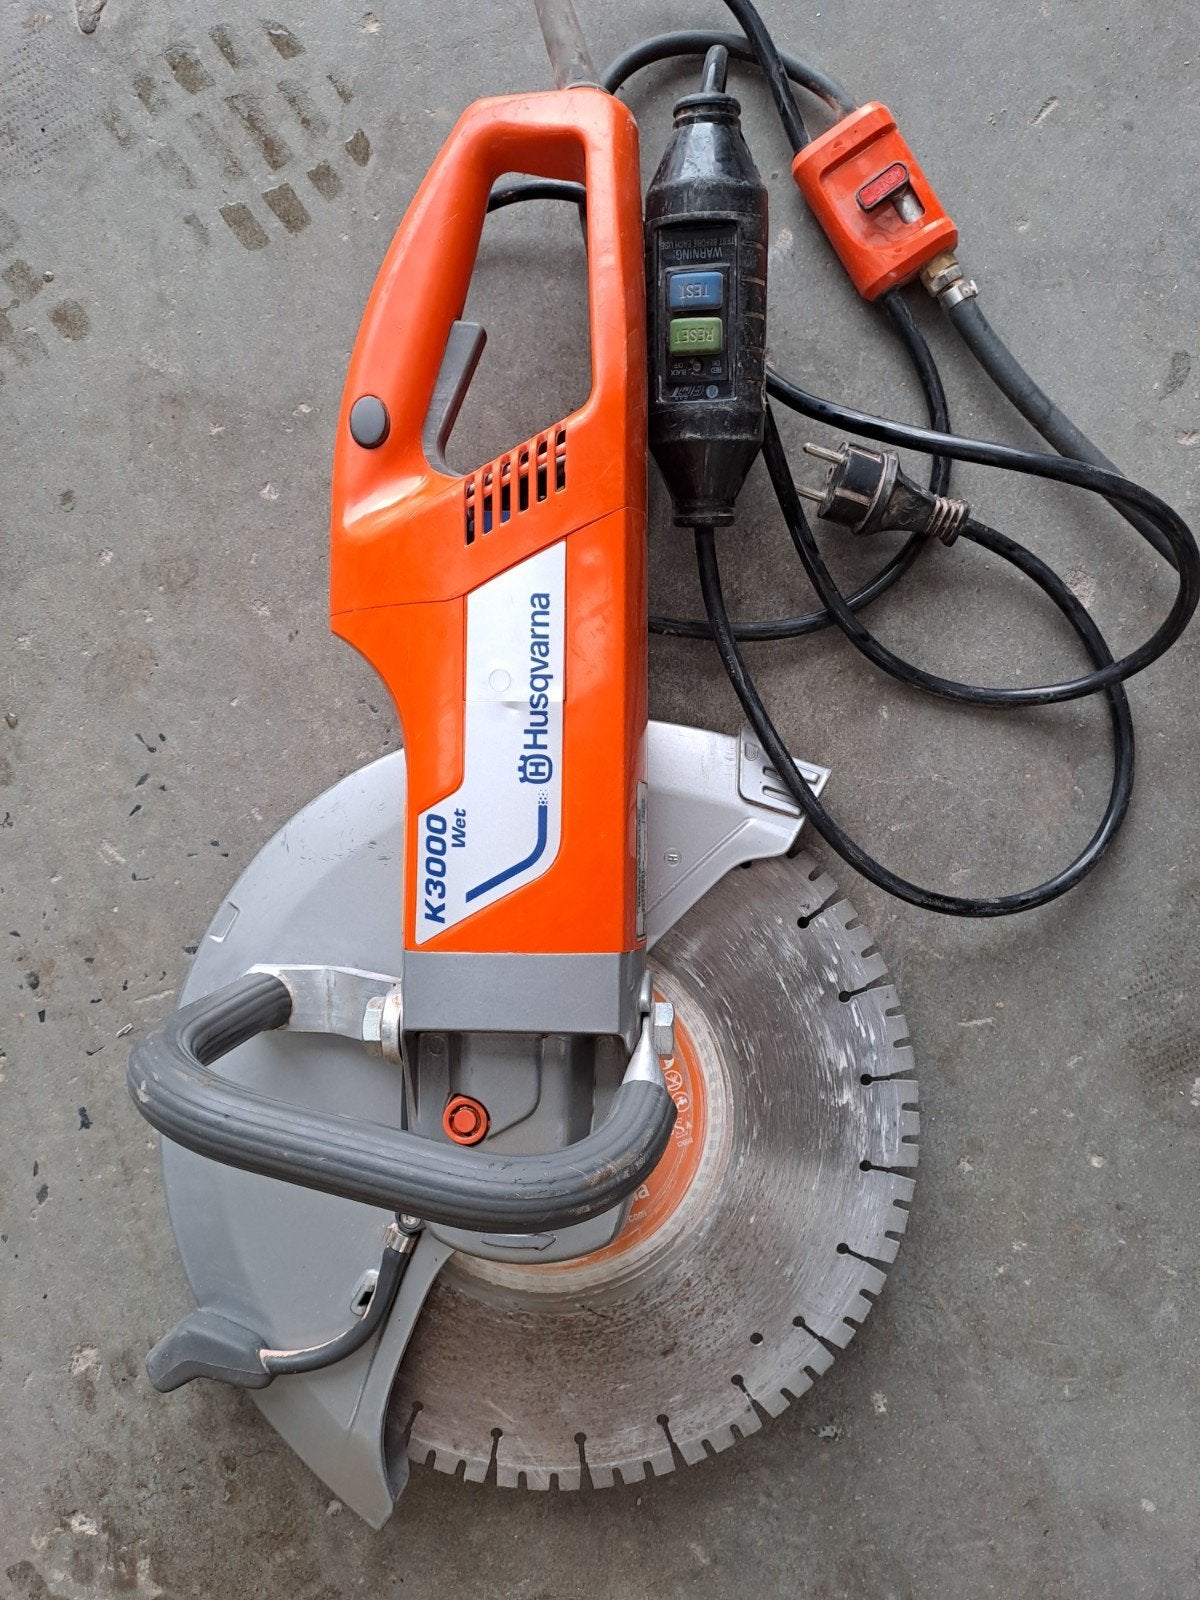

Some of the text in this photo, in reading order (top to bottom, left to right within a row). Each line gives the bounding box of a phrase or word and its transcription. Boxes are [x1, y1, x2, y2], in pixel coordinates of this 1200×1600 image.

[672, 246, 723, 261] WARNING:
[679, 283, 710, 299] TEST
[674, 327, 714, 344] RESET
[523, 592, 553, 750] Husqvarna
[451, 808, 467, 848] Wet
[424, 813, 447, 923] K3000
